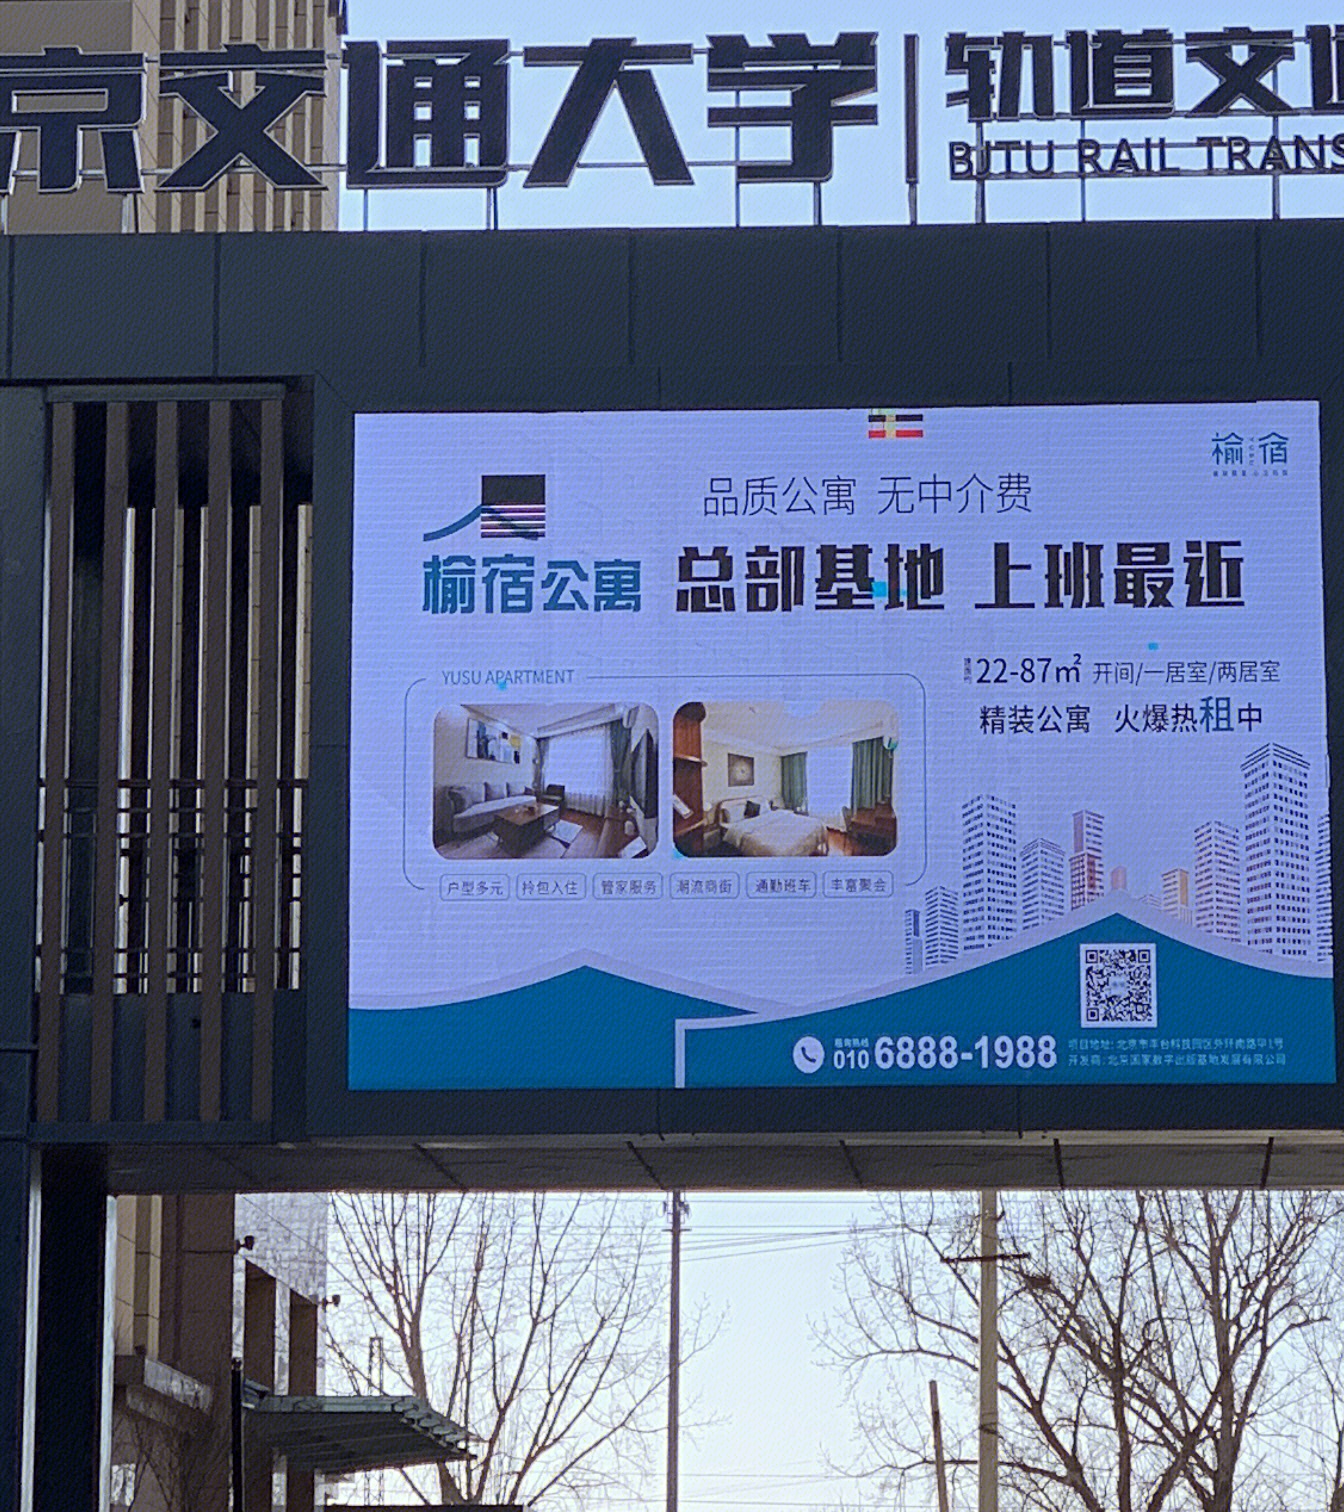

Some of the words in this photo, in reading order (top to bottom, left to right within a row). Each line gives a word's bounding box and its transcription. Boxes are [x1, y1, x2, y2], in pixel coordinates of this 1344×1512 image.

[949, 138, 1056, 180] BJTU
[1077, 136, 1181, 175] RAIL
[702, 474, 858, 517] 品质公寓
[876, 472, 1034, 514] 无中介费
[422, 553, 642, 614] 榆宿公寓
[675, 543, 947, 613] 总部基地
[973, 539, 1247, 610] 上班最近
[441, 669, 482, 686] YUSU
[484, 668, 575, 686] APARTMENT
[1092, 660, 1282, 686] 开间/一居室/两居室
[978, 704, 1092, 736] 精装公寓
[1113, 695, 1264, 734] 火爆热租中
[445, 880, 506, 898] 户型多元
[520, 880, 580, 897] 拎包入住
[599, 879, 658, 897] 管家服务
[754, 877, 812, 895] 通勤班车
[829, 877, 888, 895] 丰富聚会
[833, 1049, 870, 1070] 010
[874, 1034, 1058, 1070] 6888-1988
